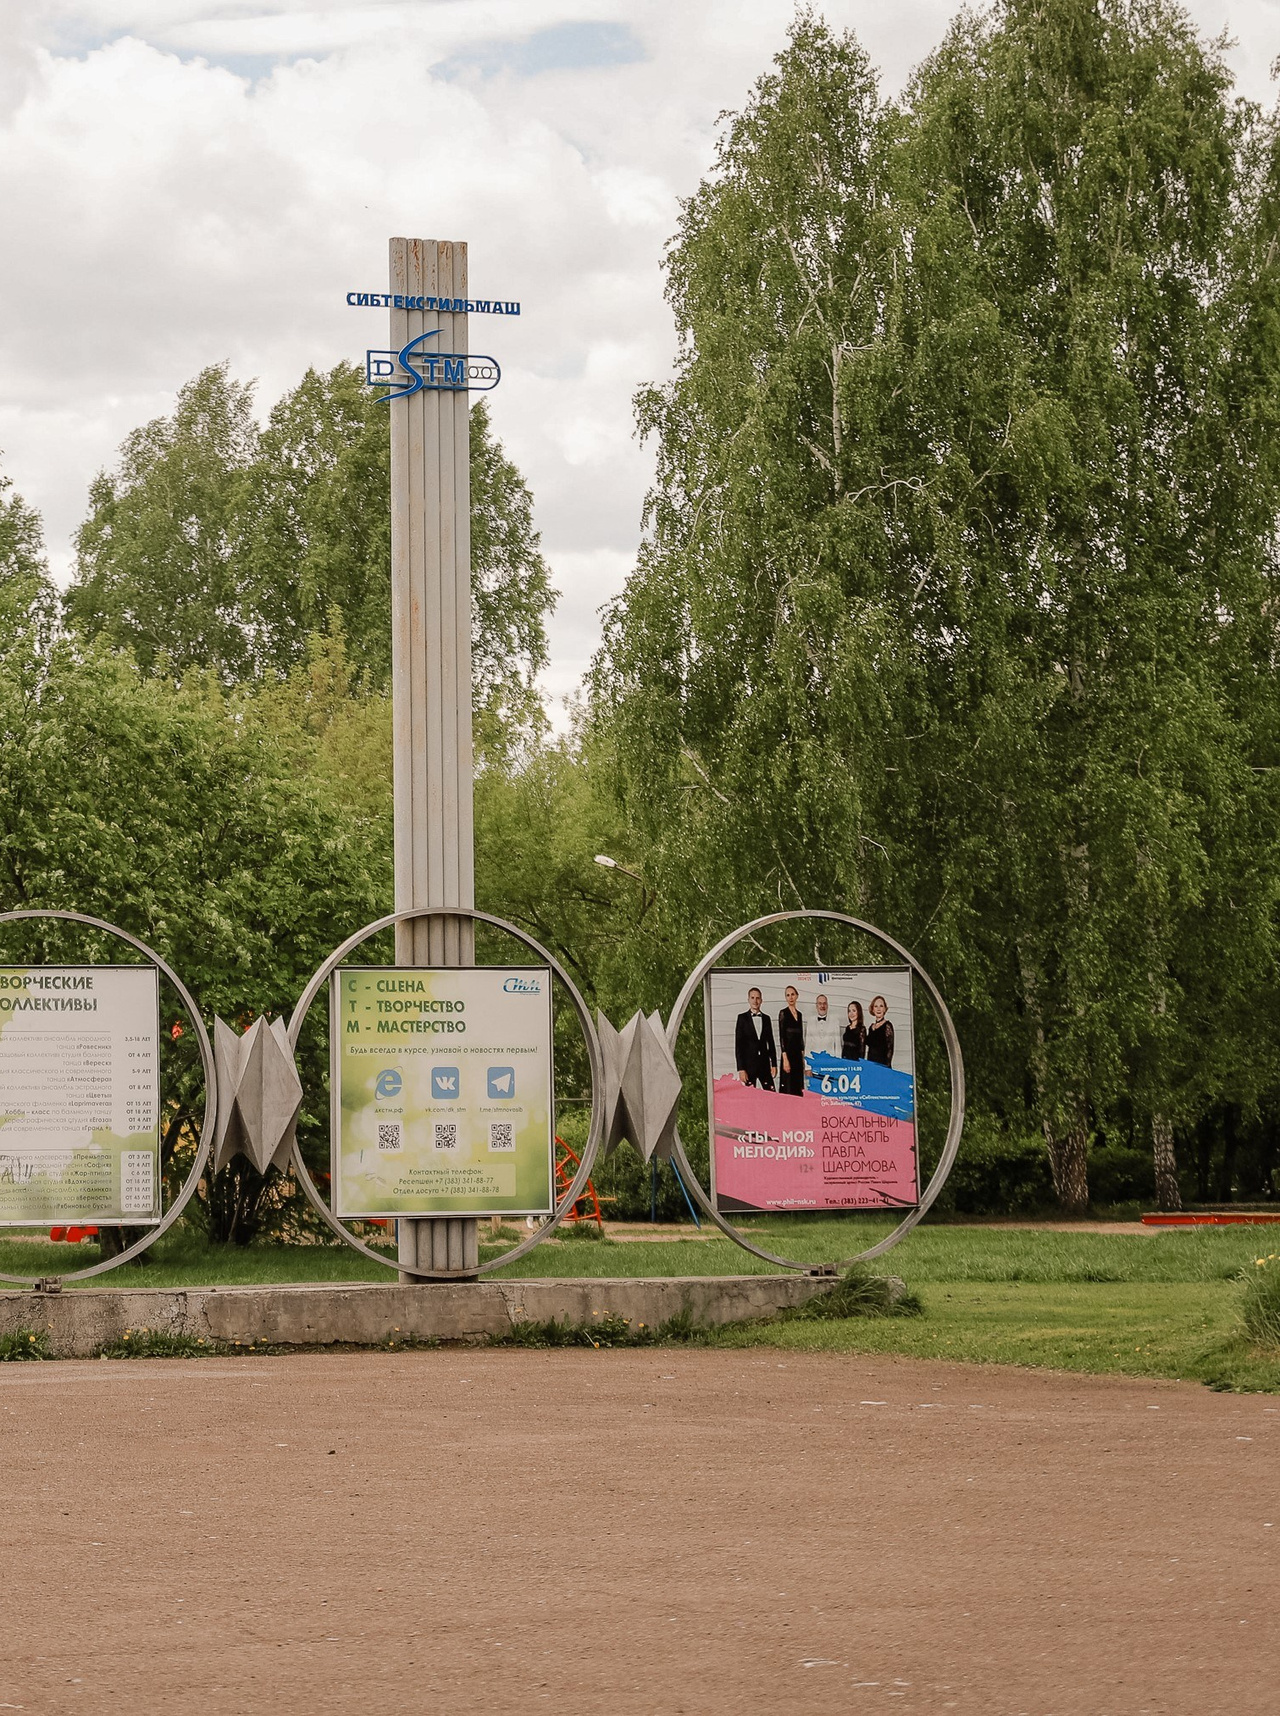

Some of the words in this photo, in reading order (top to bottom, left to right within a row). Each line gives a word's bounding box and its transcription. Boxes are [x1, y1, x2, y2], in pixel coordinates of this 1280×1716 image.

[346, 292, 520, 315] СИБТЕКСТИЛЬМАШ
[348, 980, 357, 992] С
[377, 980, 426, 993] СЦЕНА
[349, 1000, 357, 1012] Т
[377, 1000, 465, 1013] ТВОРЧЕСТВО
[346, 1020, 360, 1033] М
[377, 1020, 466, 1033] МАСТЕРСТВО
[350, 1046, 367, 1054] Будь
[431, 1046, 461, 1055] узнавай
[506, 1047, 538, 1055] первым!
[821, 1074, 861, 1093] 6.04
[821, 1116, 898, 1128] ВОКАЛЬНЫЙ
[737, 1131, 768, 1143] «ТЫ
[782, 1131, 814, 1142] МОЯ
[822, 1131, 890, 1143] АНСАМБЛЬ
[733, 1146, 815, 1160] МЕЛОДИЯ»
[822, 1146, 865, 1157] ПАВЛА
[800, 1164, 814, 1173] 12+
[823, 1160, 897, 1172] ШАРОМОВА
[444, 1177, 461, 1185] (383)
[393, 1187, 415, 1195] Отдел
